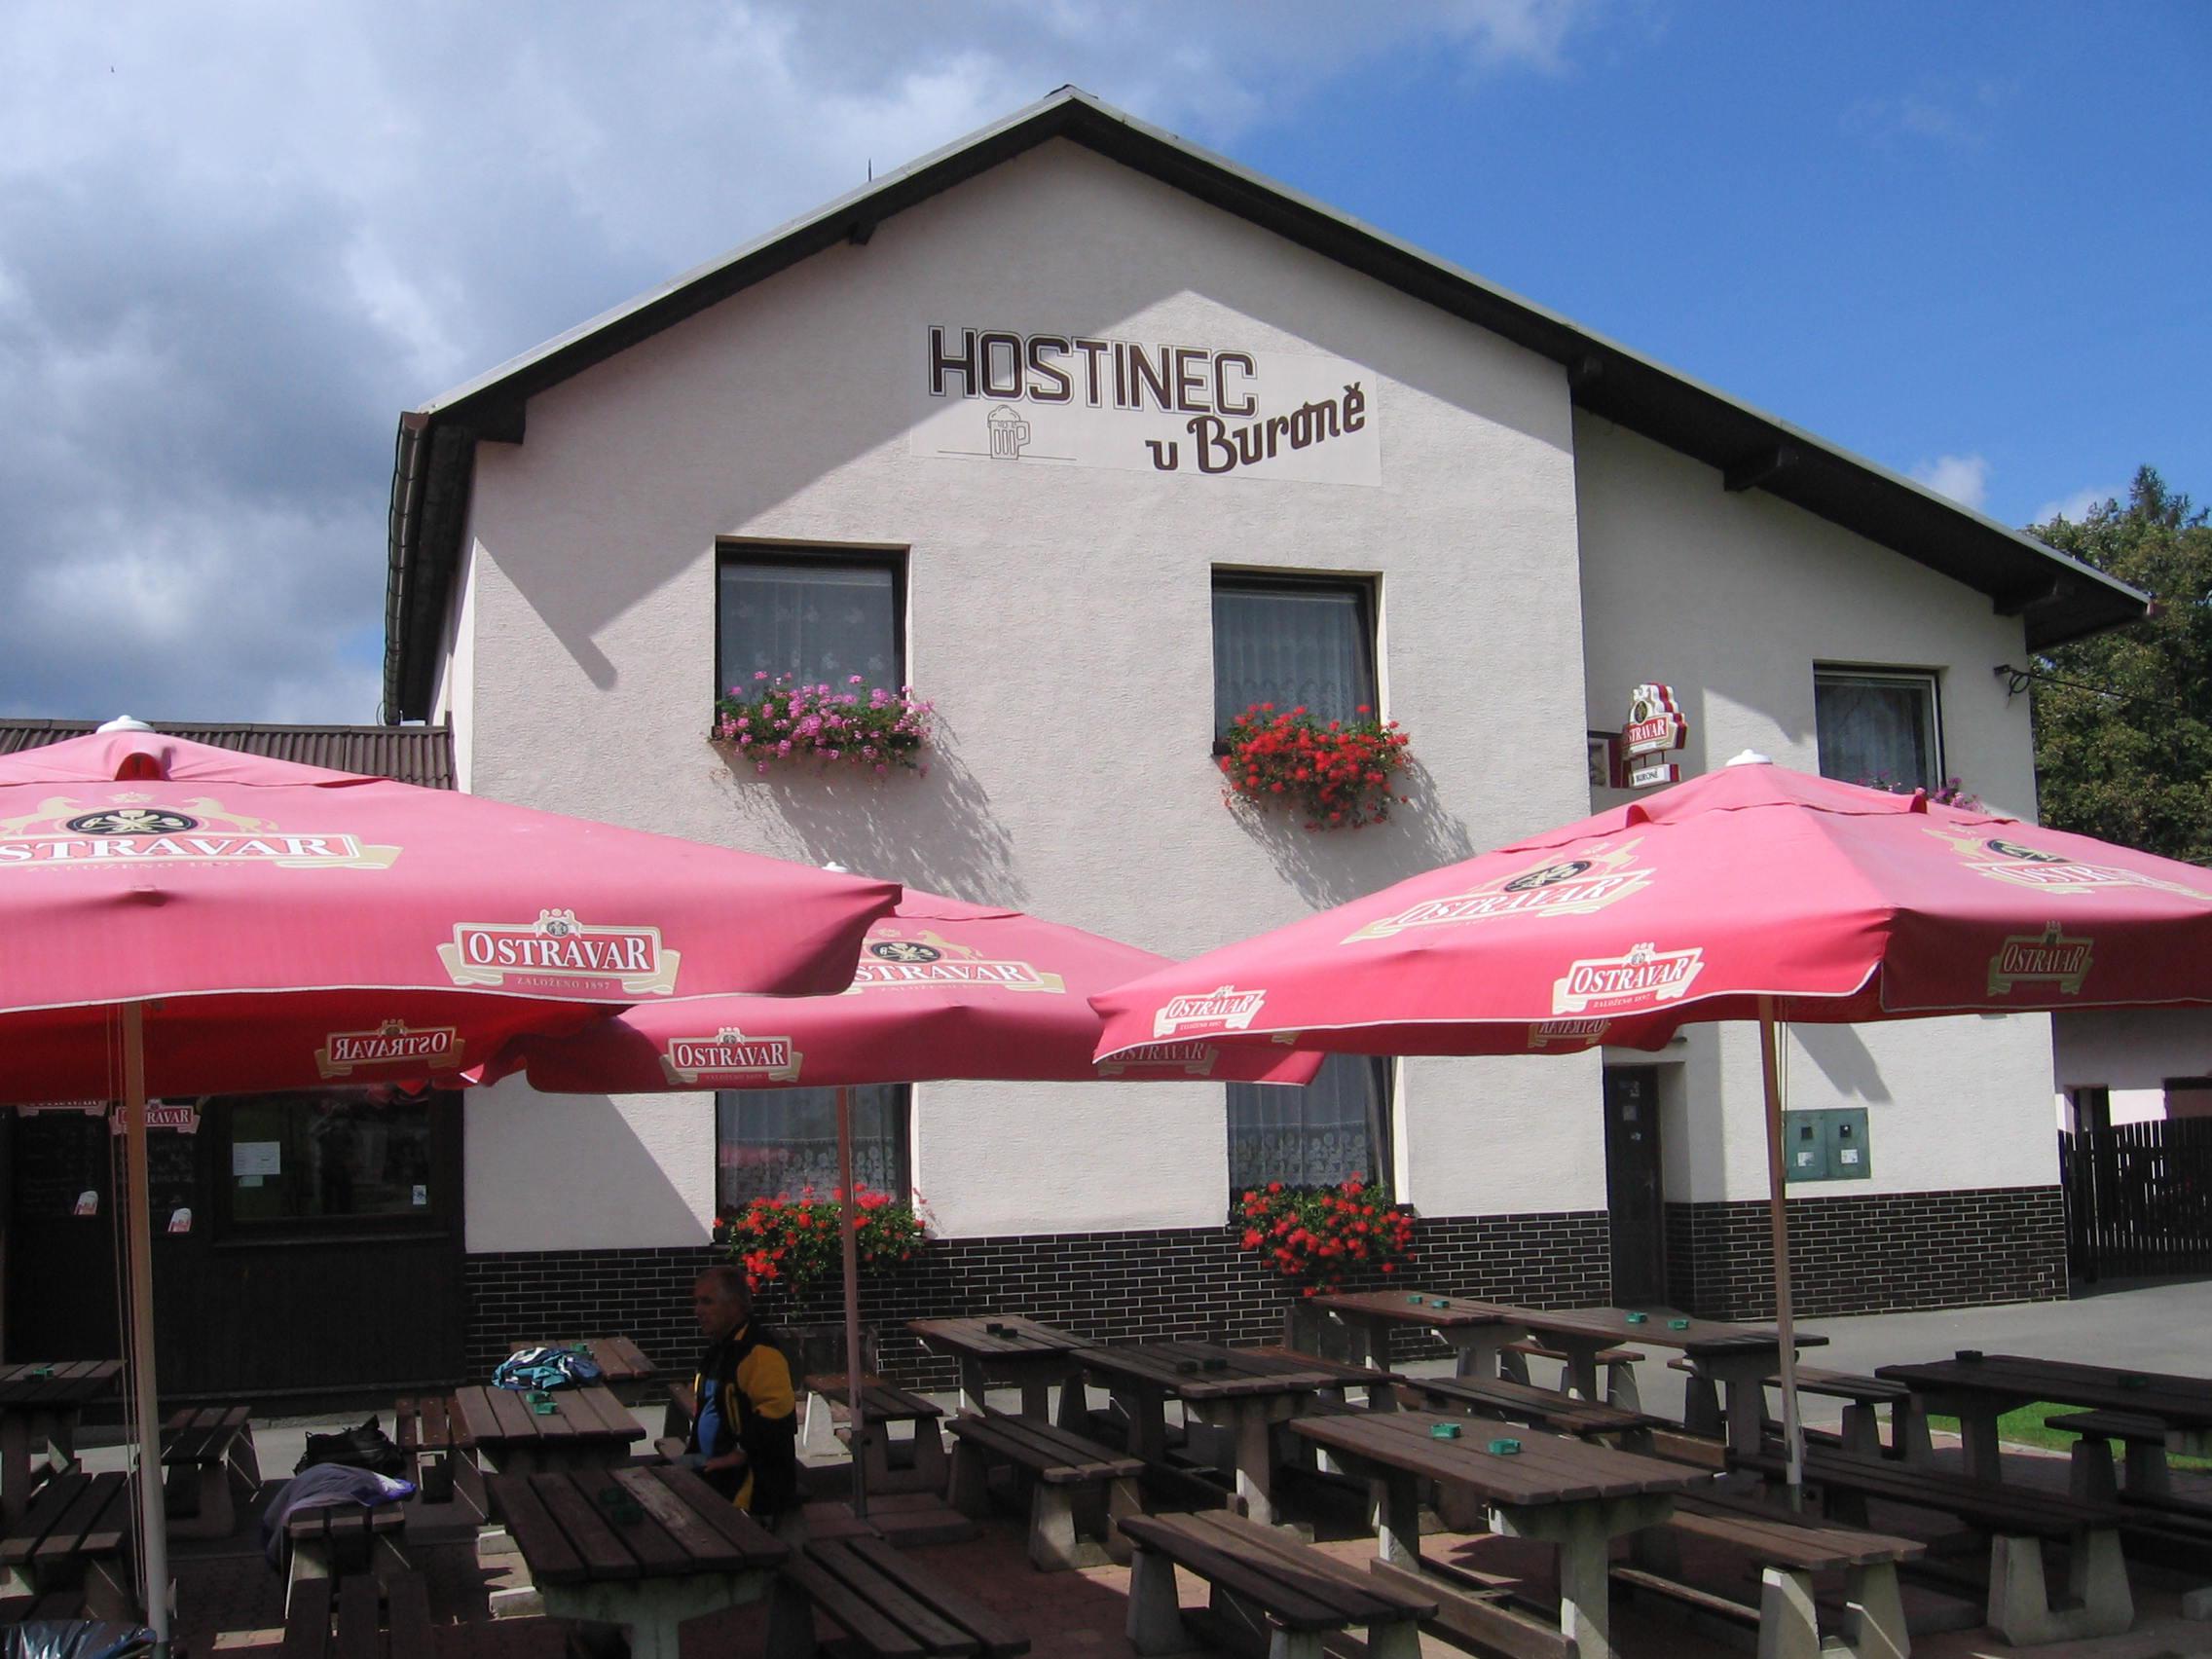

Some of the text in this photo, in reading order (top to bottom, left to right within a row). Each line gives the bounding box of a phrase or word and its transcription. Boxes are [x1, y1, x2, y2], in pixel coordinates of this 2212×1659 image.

[929, 325, 1259, 419] HOSTINEC
[0, 836, 336, 863] STRAVAR
[1397, 877, 1624, 924] OSTRAVAR
[469, 932, 650, 971] OSTRAVAR
[2003, 944, 2086, 973] OSTRAVAR
[853, 964, 1030, 982] STRAVAR
[1573, 957, 1689, 994] OSTRAVAR
[1168, 995, 1254, 1017] OSTRAVAR
[678, 1043, 786, 1067] OSTRAVAR
